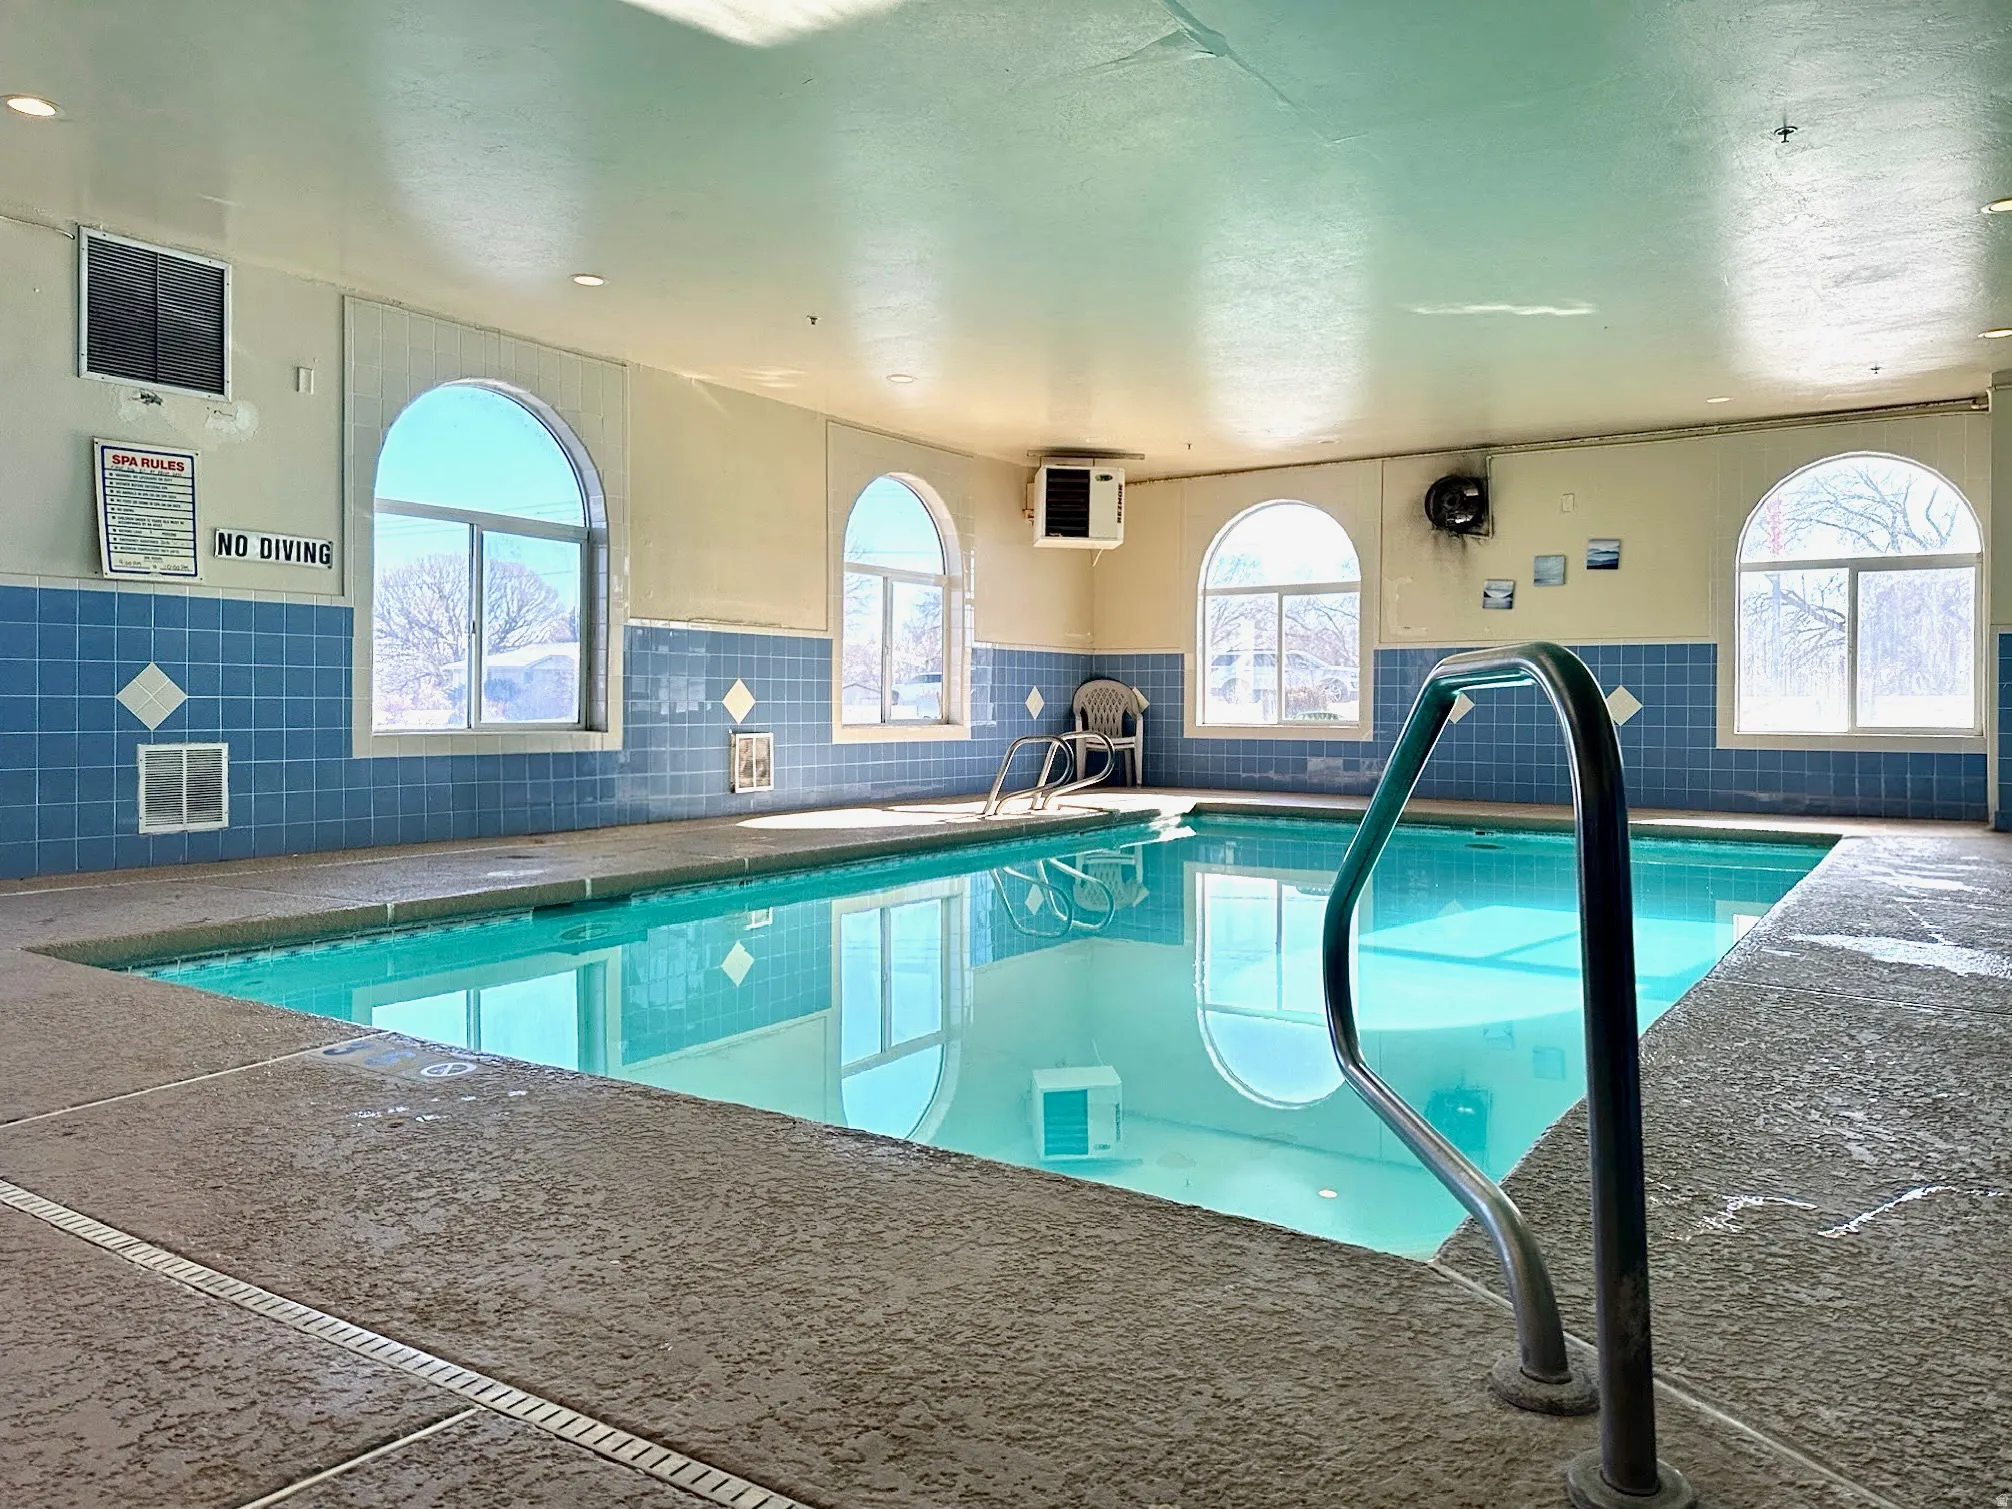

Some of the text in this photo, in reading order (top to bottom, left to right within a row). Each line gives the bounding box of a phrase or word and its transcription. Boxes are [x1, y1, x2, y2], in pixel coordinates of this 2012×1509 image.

[112, 454, 138, 467] SPA
[141, 457, 185, 472] RULES
[218, 532, 331, 565] NO DIVING
